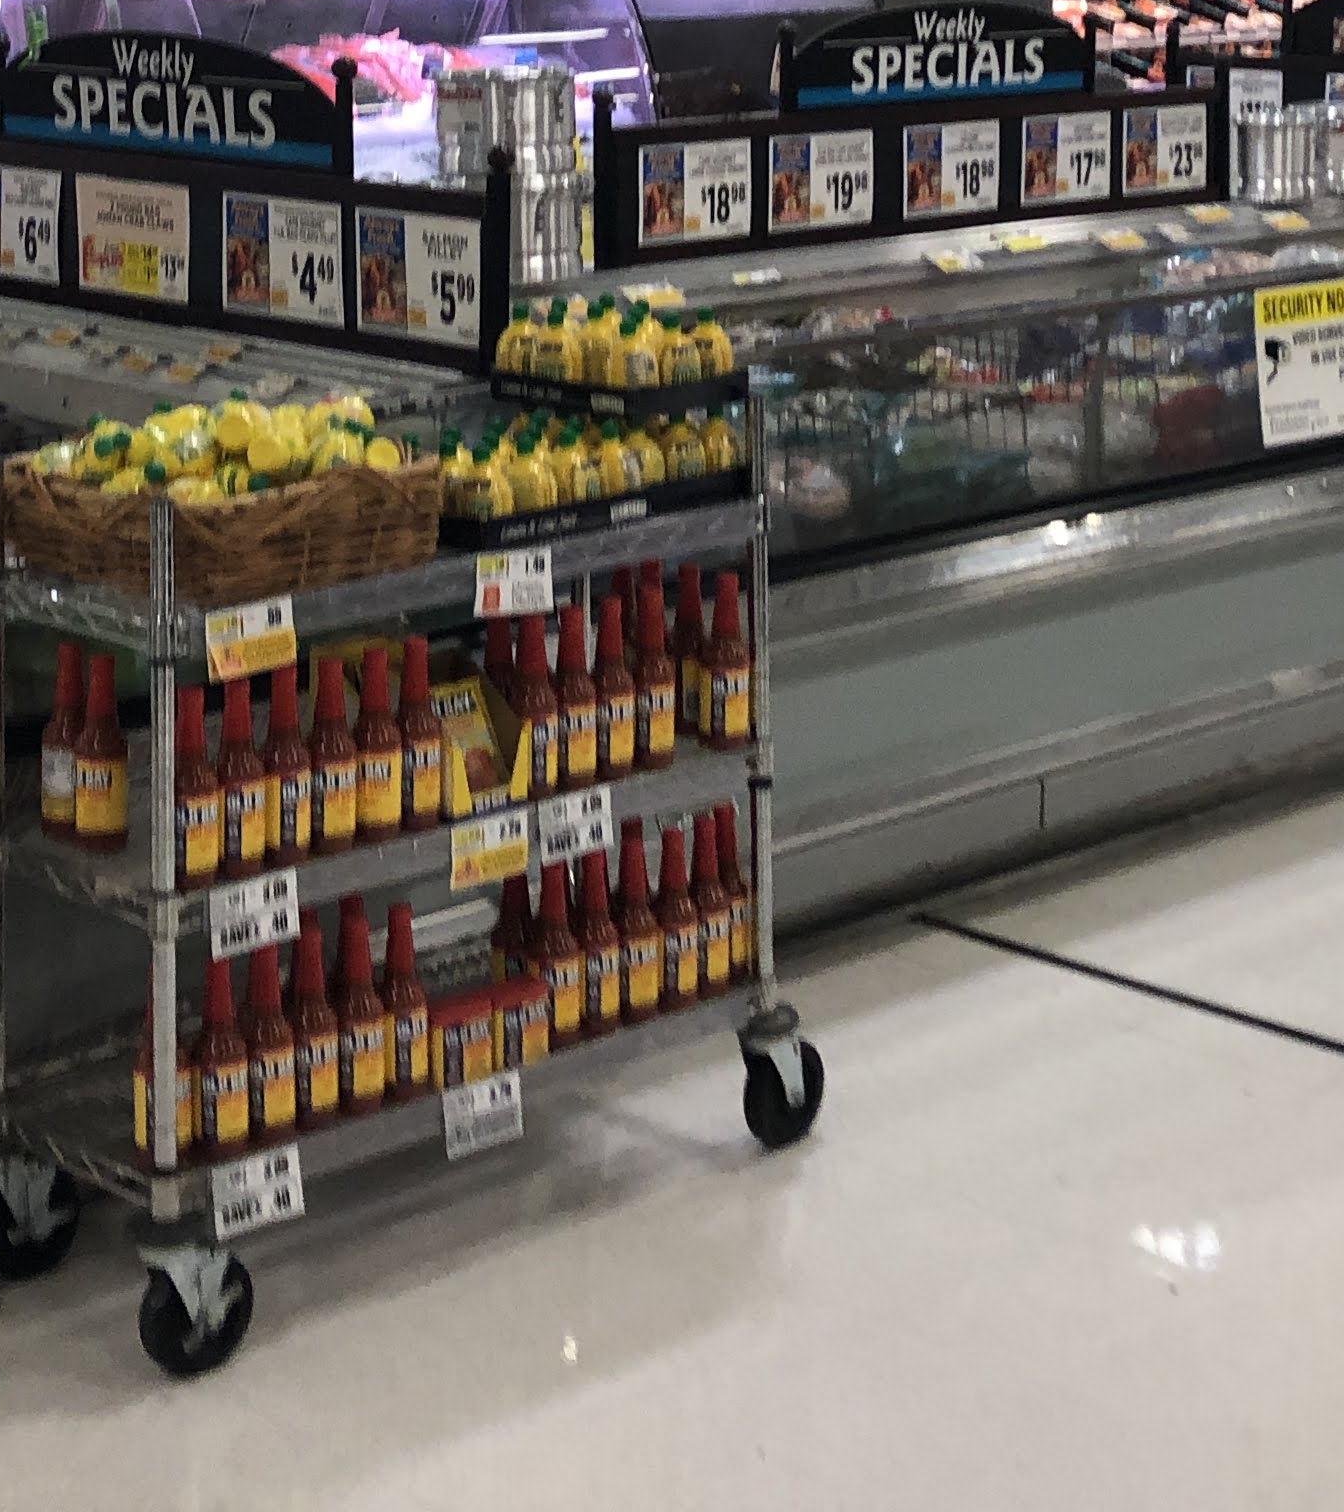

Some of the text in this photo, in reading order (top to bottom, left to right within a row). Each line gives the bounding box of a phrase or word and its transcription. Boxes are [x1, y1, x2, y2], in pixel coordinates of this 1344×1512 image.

[913, 9, 986, 44] Weekly
[112, 38, 195, 87] Weekly
[851, 37, 1046, 95] SPECIALS
[52, 74, 278, 148] SPECIALS
[1263, 290, 1324, 324] SECURITY
